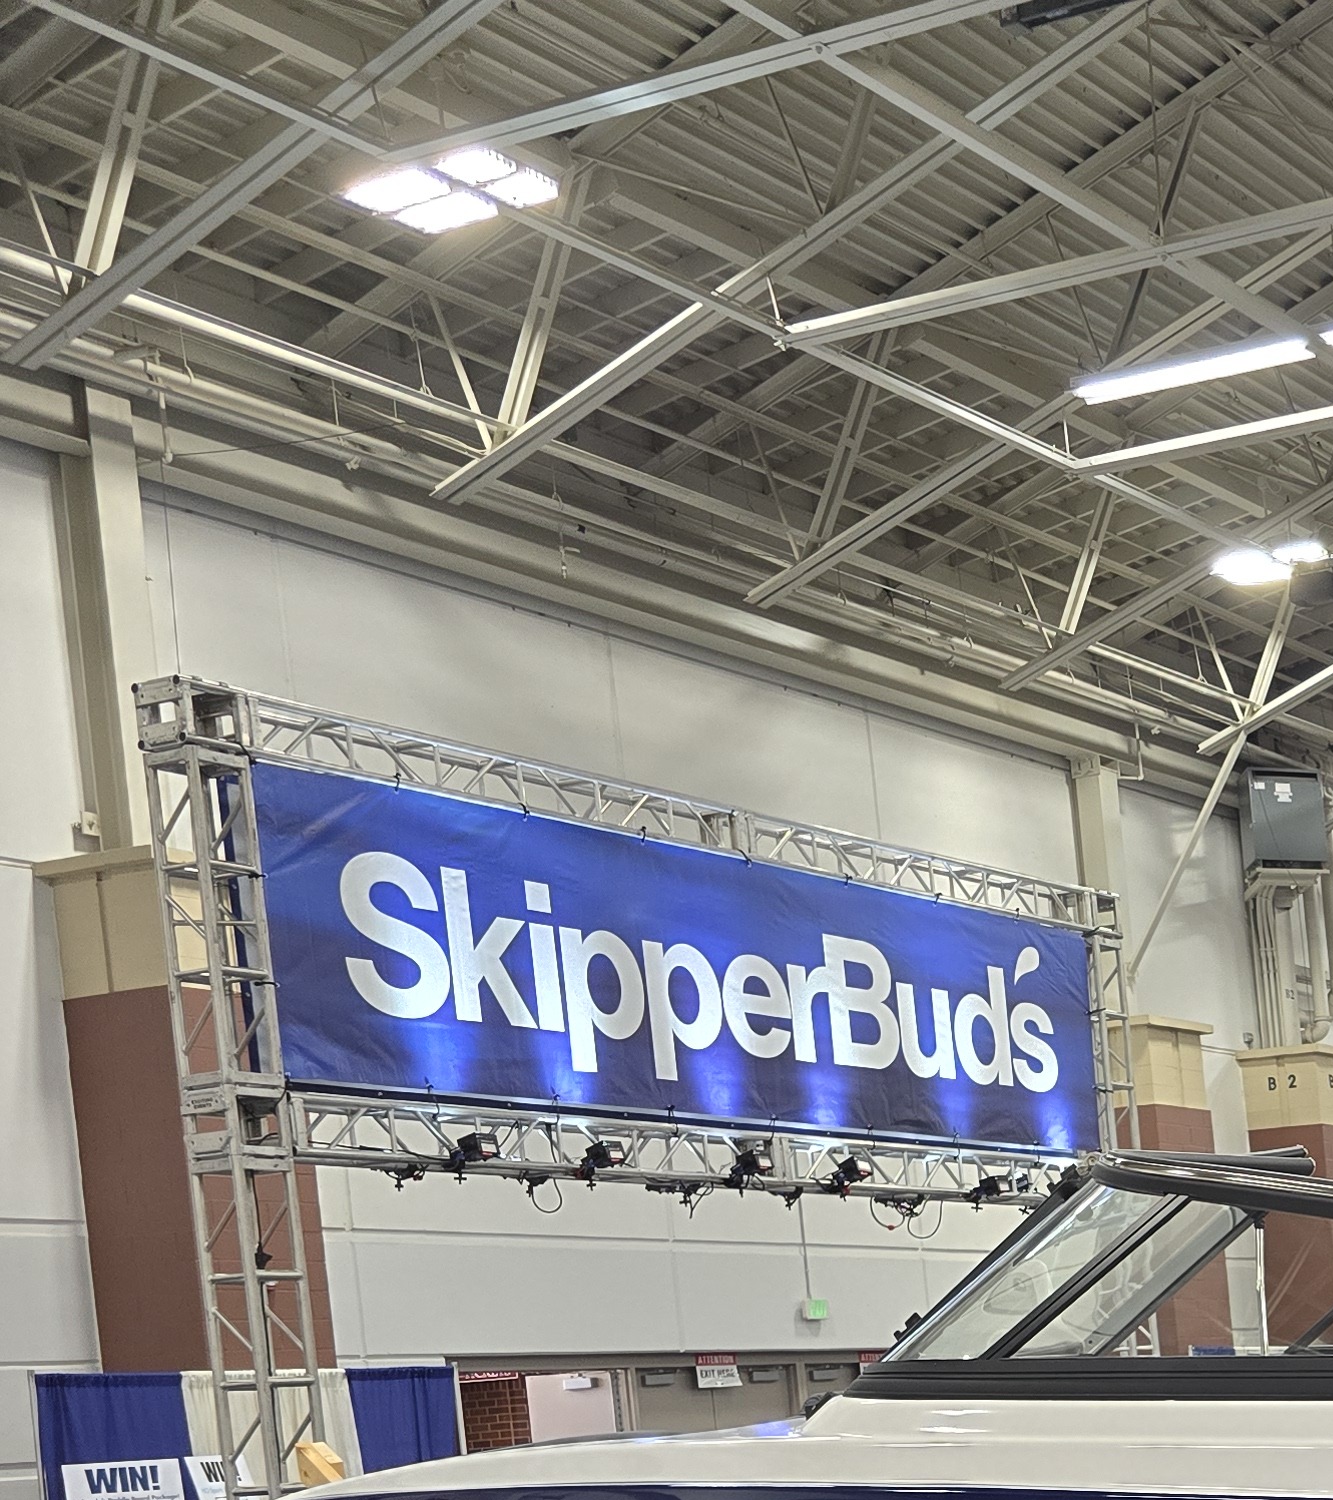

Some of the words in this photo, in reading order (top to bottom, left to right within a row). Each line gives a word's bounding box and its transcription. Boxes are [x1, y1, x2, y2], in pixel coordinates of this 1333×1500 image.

[1287, 1074, 1297, 1088] 2
[697, 1355, 735, 1364] ATTENTION
[700, 1369, 715, 1379] EXIT
[84, 1465, 161, 1494] WIN!
